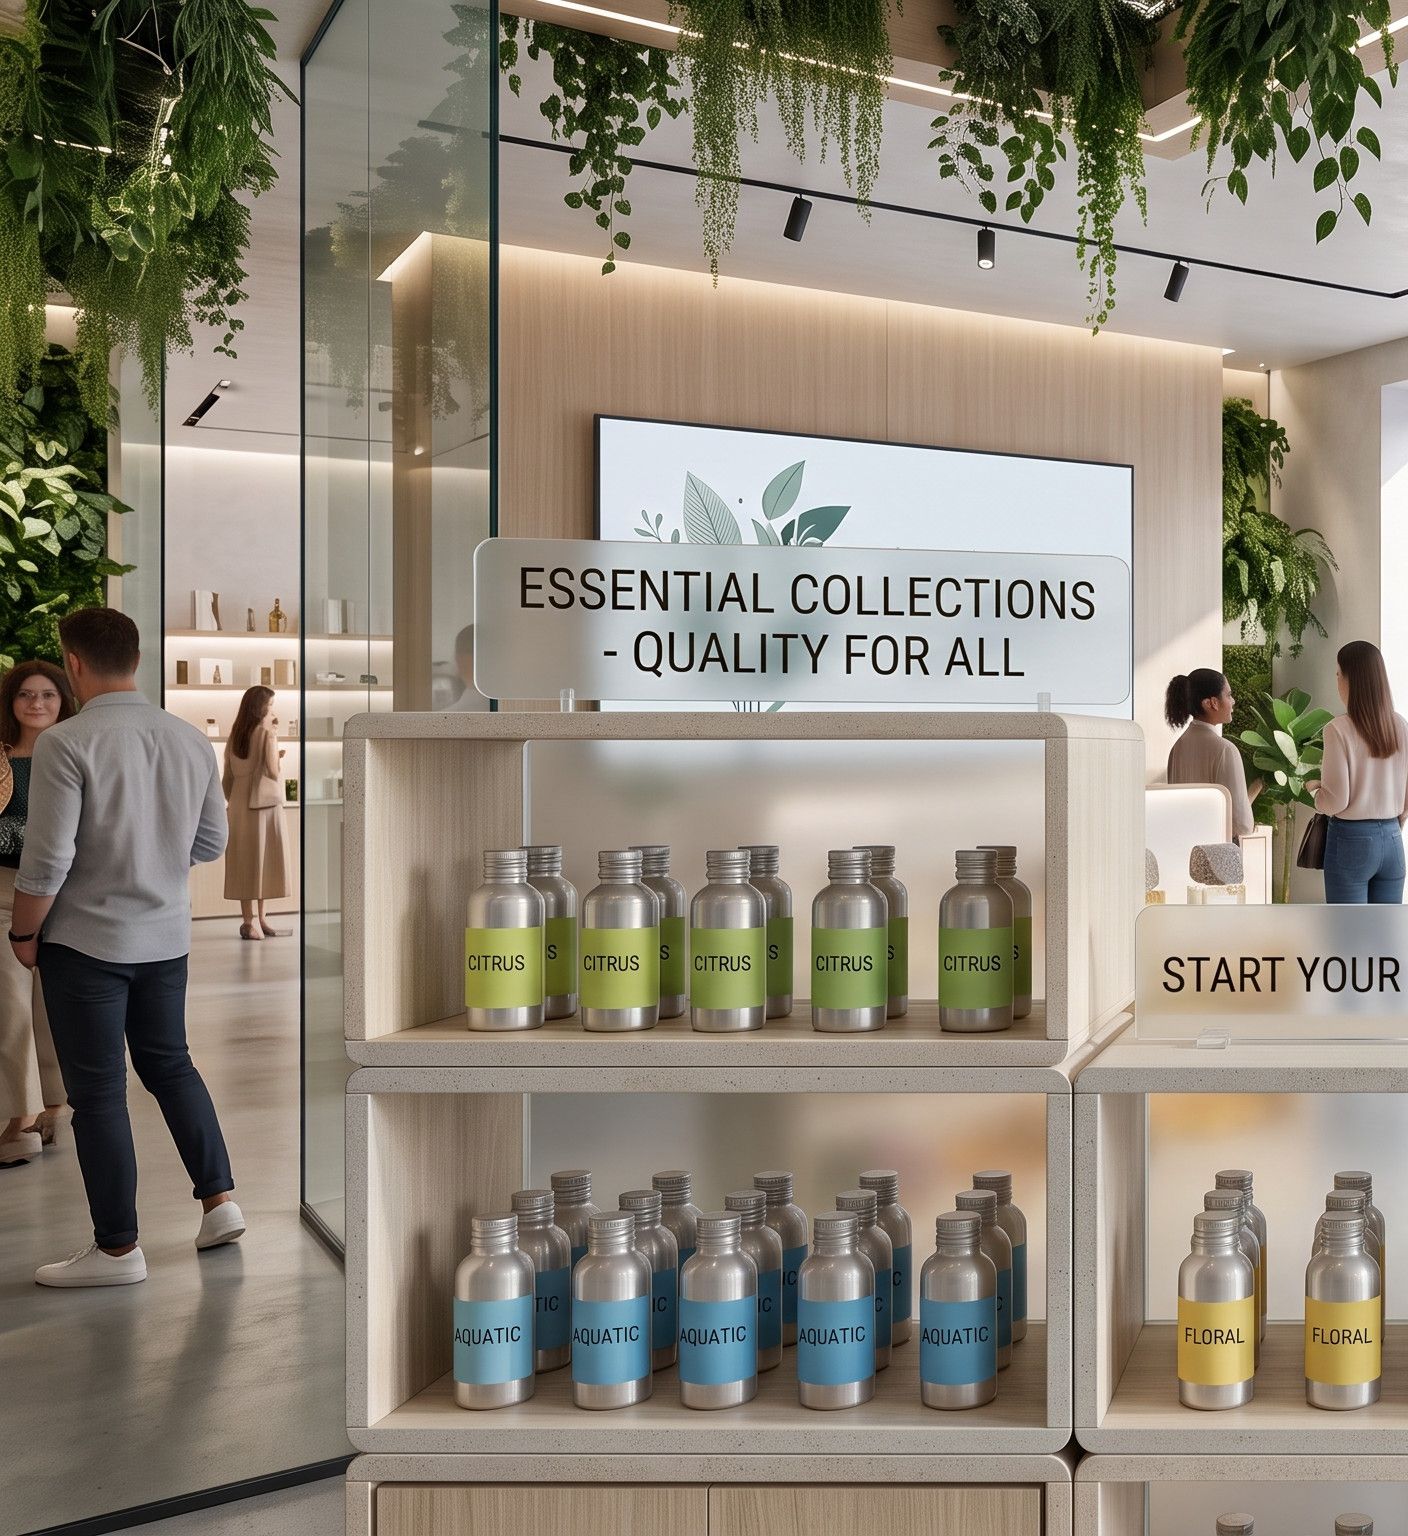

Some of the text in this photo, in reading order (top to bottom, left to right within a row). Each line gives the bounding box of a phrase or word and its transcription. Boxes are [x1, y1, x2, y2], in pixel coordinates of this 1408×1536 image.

[520, 566, 1095, 621] ESSENTIAL COLLECTIONS
[634, 630, 829, 678] QUALITY
[846, 634, 930, 676] FOR
[944, 636, 1025, 677] ALL
[468, 955, 525, 972] CITRUS
[583, 954, 640, 972] CITRUS
[694, 955, 751, 972] CITRUS
[815, 955, 873, 972] CITRUS
[943, 954, 1001, 972] CITRUS
[1162, 956, 1285, 993] START
[1296, 956, 1401, 993] YOUR
[454, 1326, 521, 1347] AQUATIC
[572, 1325, 640, 1346] AQUATIC
[679, 1325, 747, 1347] AQUATIC
[798, 1326, 866, 1347] AQUATIC
[921, 1326, 989, 1347] AQUATIC
[1185, 1327, 1245, 1345] FLORAL
[1312, 1326, 1373, 1345] FLORAL
